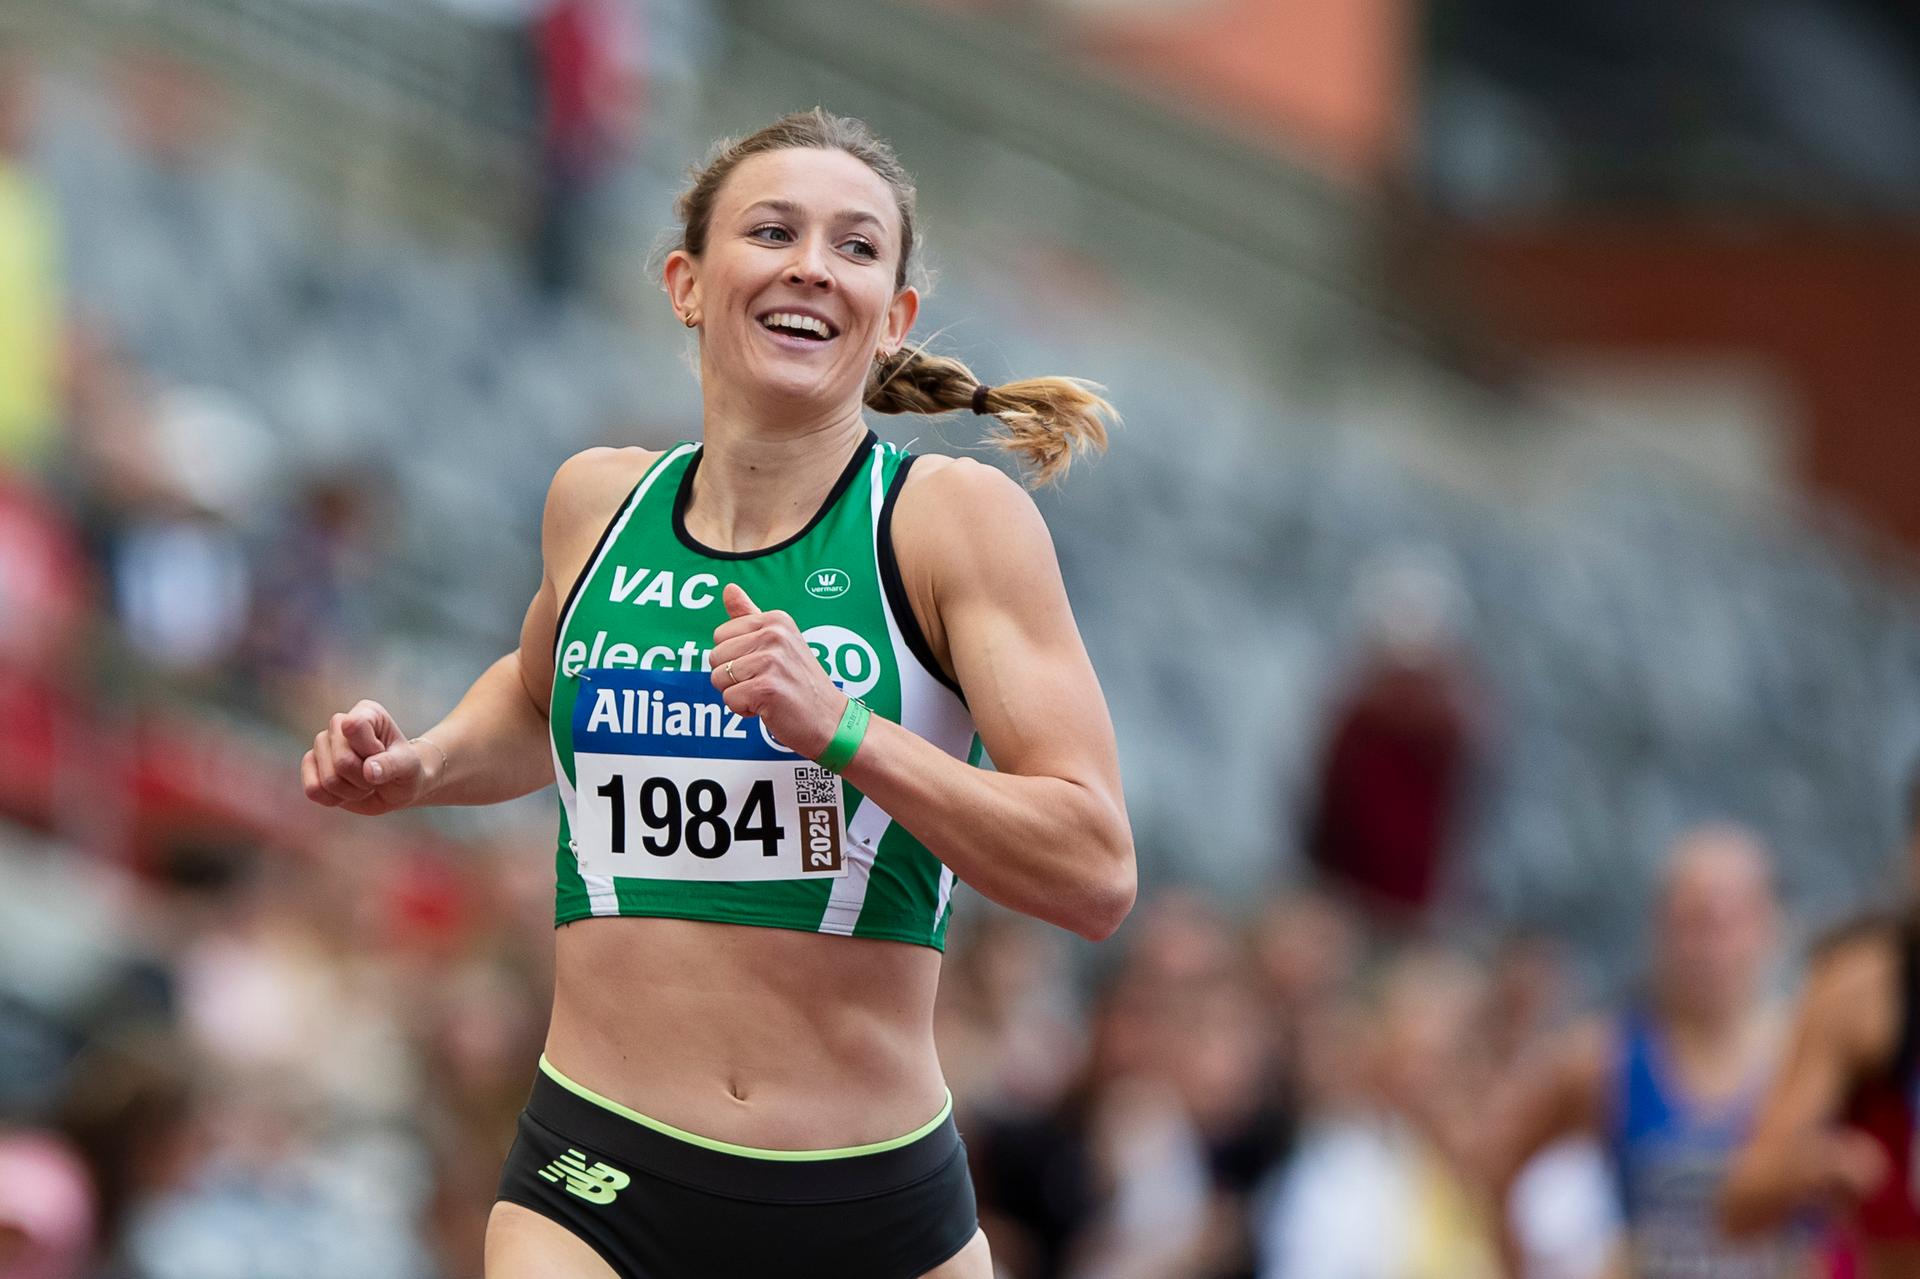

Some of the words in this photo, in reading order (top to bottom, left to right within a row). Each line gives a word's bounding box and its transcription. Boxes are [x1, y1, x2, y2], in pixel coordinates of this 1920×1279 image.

[608, 565, 719, 610] VAC
[586, 687, 747, 739] Allianz
[597, 774, 785, 859] 1984
[809, 809, 832, 867] 2025
[537, 1148, 631, 1205] NB
